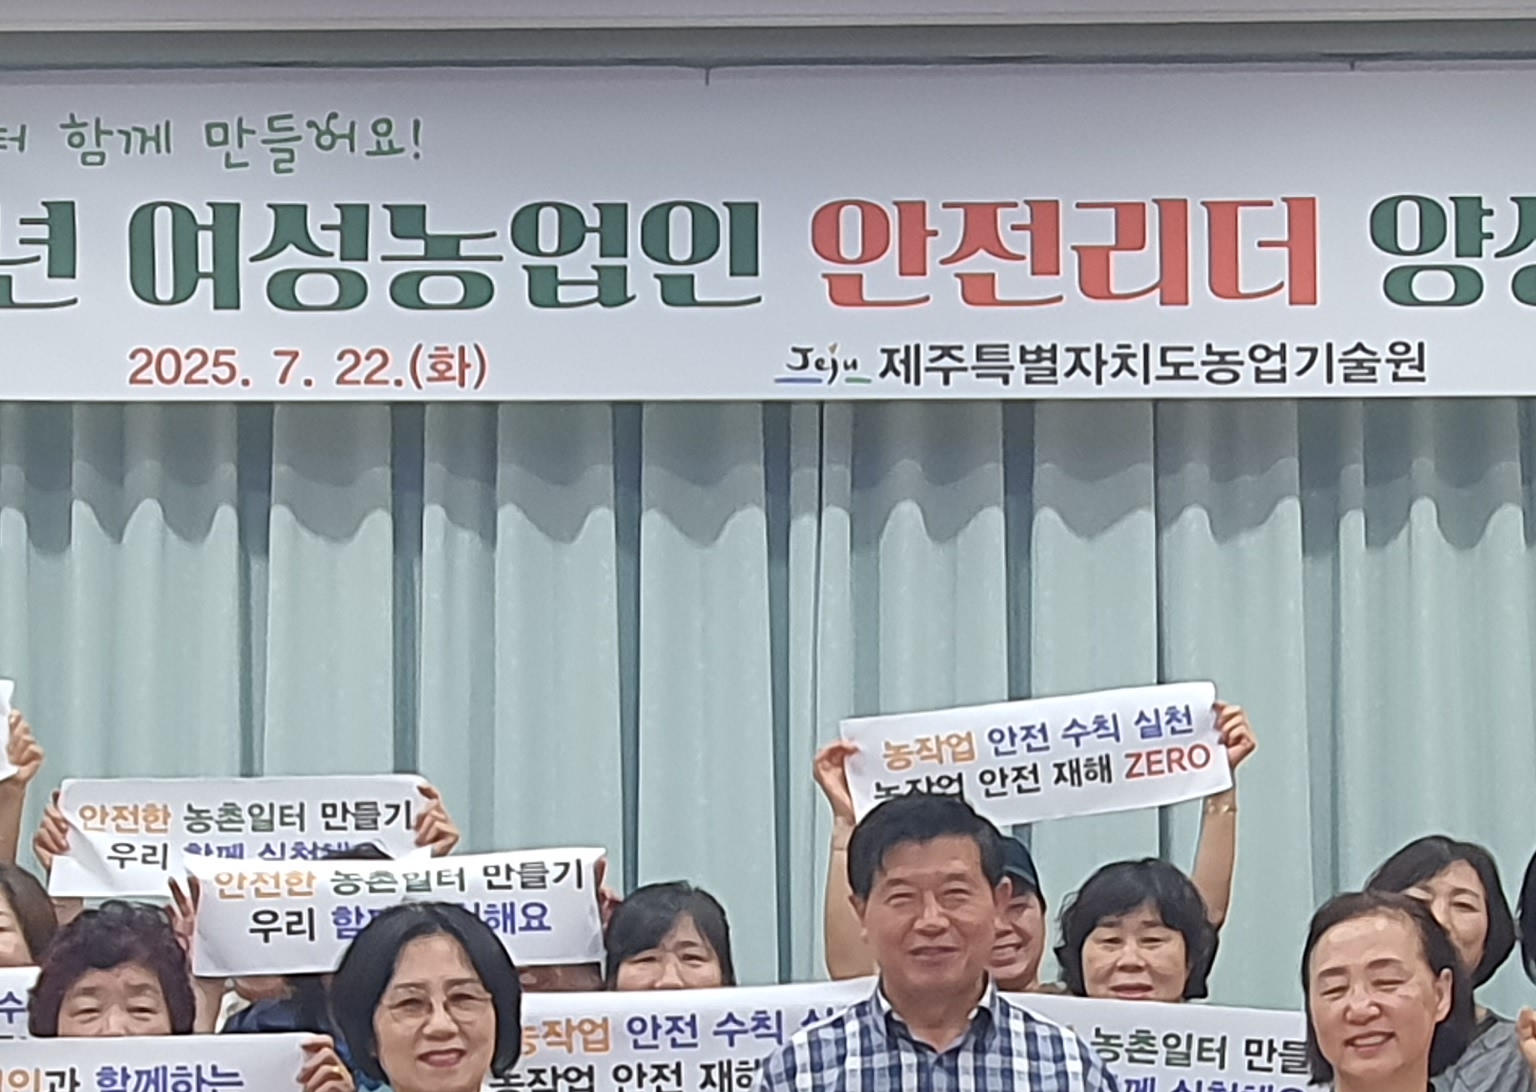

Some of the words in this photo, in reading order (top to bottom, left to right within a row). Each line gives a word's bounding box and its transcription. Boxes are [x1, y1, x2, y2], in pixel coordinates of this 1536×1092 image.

[59, 112, 172, 167] 함께
[204, 111, 421, 174] 만들어요!
[126, 199, 760, 309] 여성농업인
[810, 194, 1317, 308] 안전리더
[126, 347, 254, 387] 2025.
[271, 347, 314, 387] 7.
[333, 343, 488, 392] 22.(화)
[786, 342, 858, 385] Jeju
[879, 340, 1427, 387] 제주특별자치도농업기술원
[882, 731, 976, 770] 농작업
[987, 723, 1050, 758] 안전
[1062, 713, 1120, 749] 수칙
[1133, 704, 1194, 739] 실천
[979, 763, 1041, 798] 안전
[1053, 756, 1113, 788] 재해
[1124, 744, 1211, 780] ZERO
[78, 803, 172, 834] 안전한
[183, 801, 307, 834] 농촌일터
[320, 800, 414, 831] 만들기
[106, 842, 170, 871] 우리
[214, 869, 316, 899] 안전한
[330, 867, 466, 897] 농촌일터
[482, 859, 584, 890] 만들기
[249, 908, 316, 943] 우리
[626, 1011, 699, 1049] 안전
[713, 1009, 783, 1047] 수칙
[1091, 1027, 1227, 1070] 농촌일터
[1244, 1038, 1310, 1075] 만들
